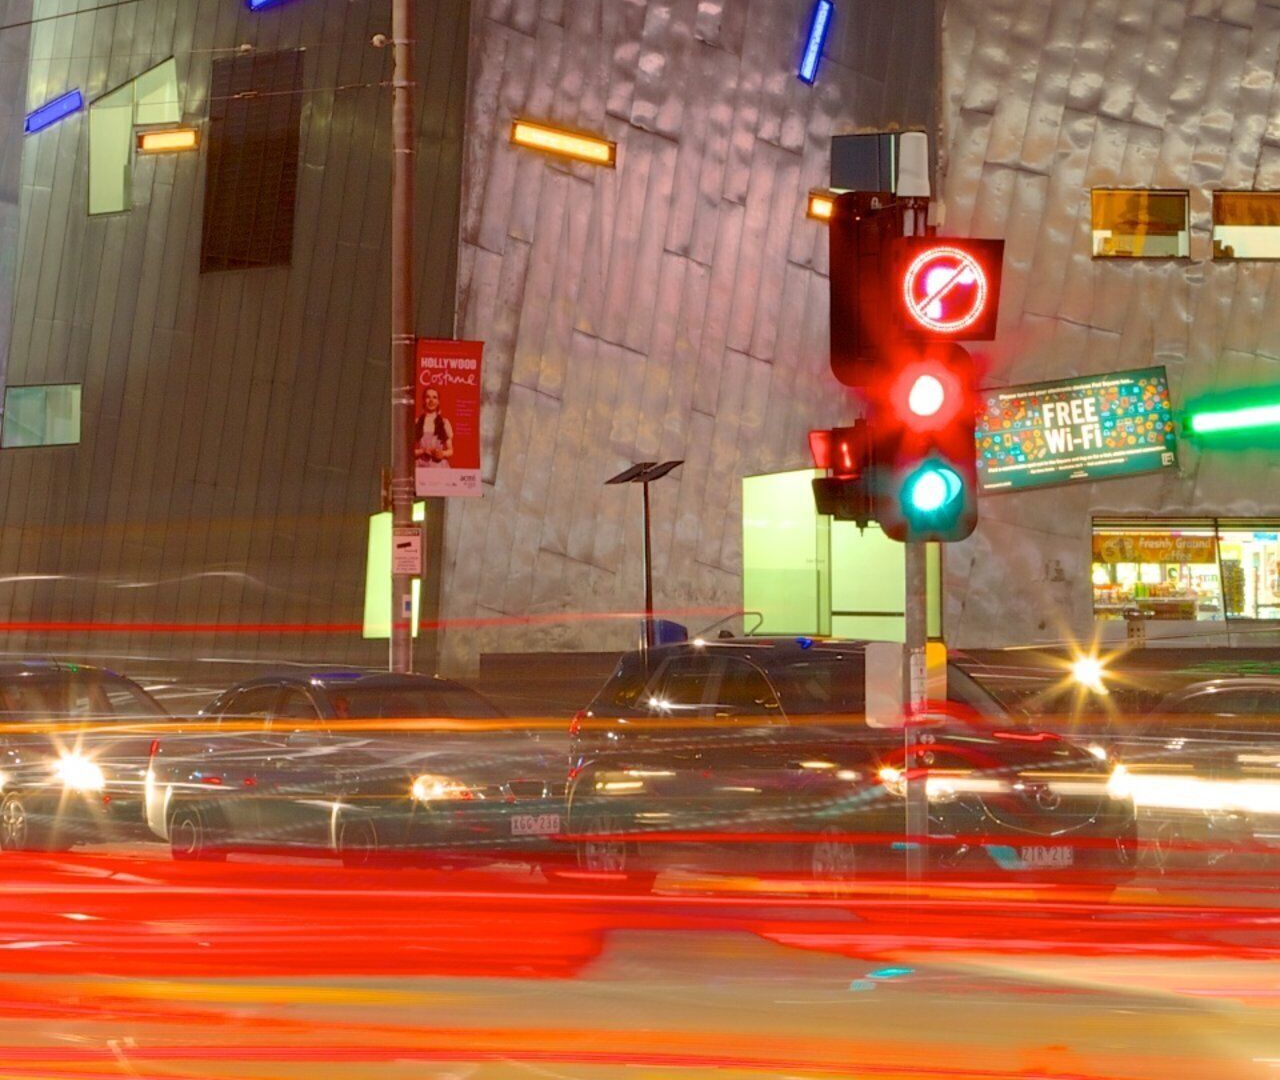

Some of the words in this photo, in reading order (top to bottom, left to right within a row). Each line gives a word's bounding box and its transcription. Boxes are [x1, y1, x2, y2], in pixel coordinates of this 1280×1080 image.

[420, 357, 477, 370] HOLLYWOOD
[420, 369, 478, 387] Costume
[1042, 397, 1099, 428] FREE
[1044, 423, 1102, 455] Wi-Fi
[1139, 537, 1172, 553] Freshly
[1175, 538, 1211, 549] Ground
